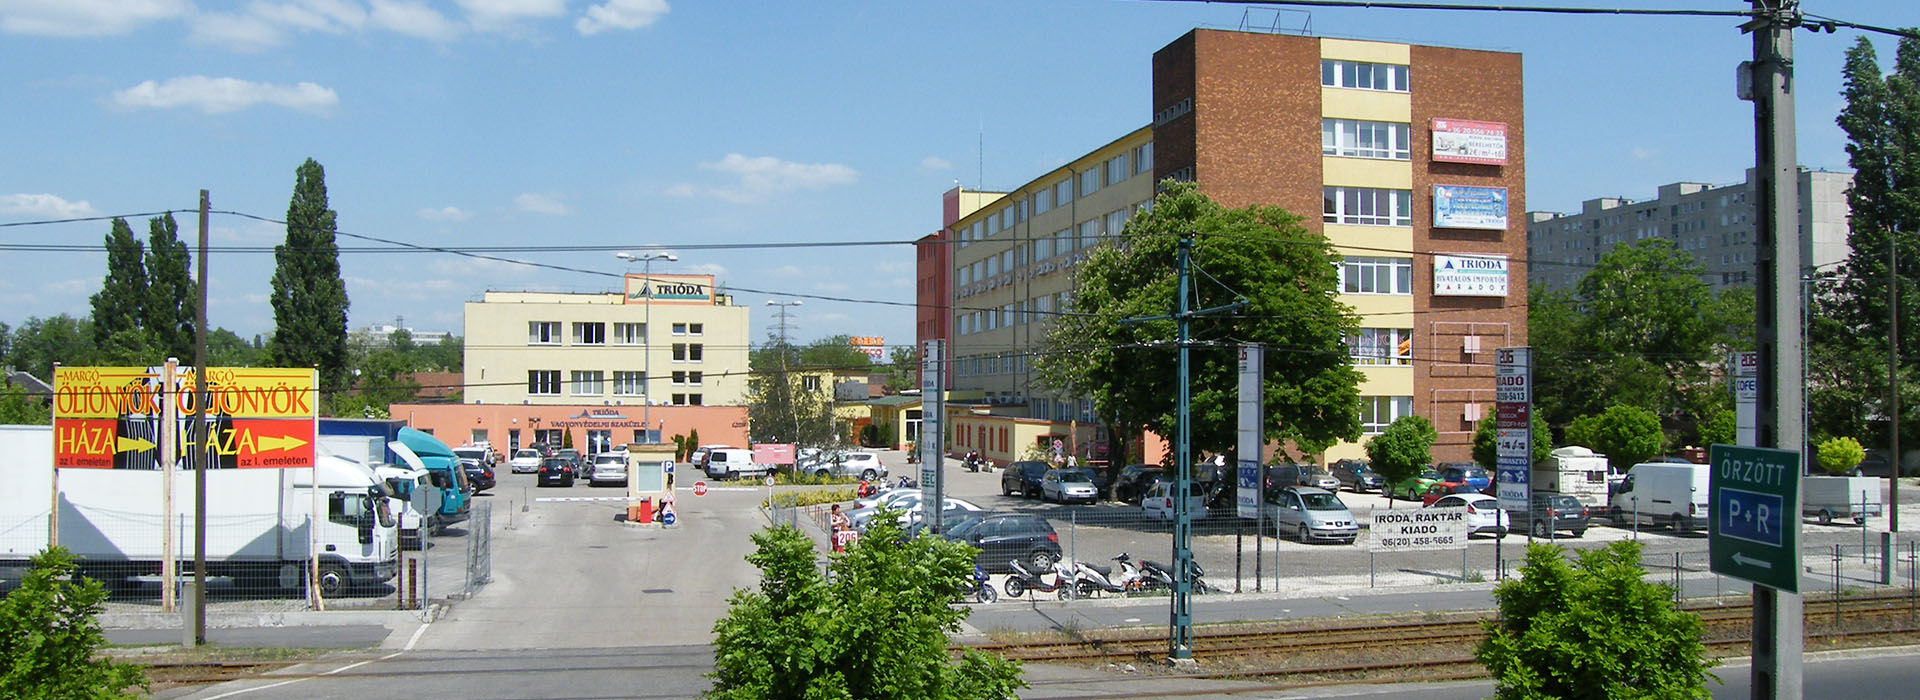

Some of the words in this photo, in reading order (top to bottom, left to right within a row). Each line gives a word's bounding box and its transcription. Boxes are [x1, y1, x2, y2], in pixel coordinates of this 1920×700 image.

[657, 282, 703, 295] TRIÓDA
[63, 370, 100, 381] MARGÓ
[57, 382, 161, 414] ÖLTÖNYÖK
[177, 382, 310, 415] ÖTÖNYÖK
[592, 408, 619, 416] TRIÓDA
[58, 422, 117, 455] HÁZA
[59, 458, 69, 466] az
[77, 458, 111, 467] emeleten
[263, 457, 308, 466] emeleten
[665, 461, 673, 472] P
[1382, 537, 1410, 547] 06(20)
